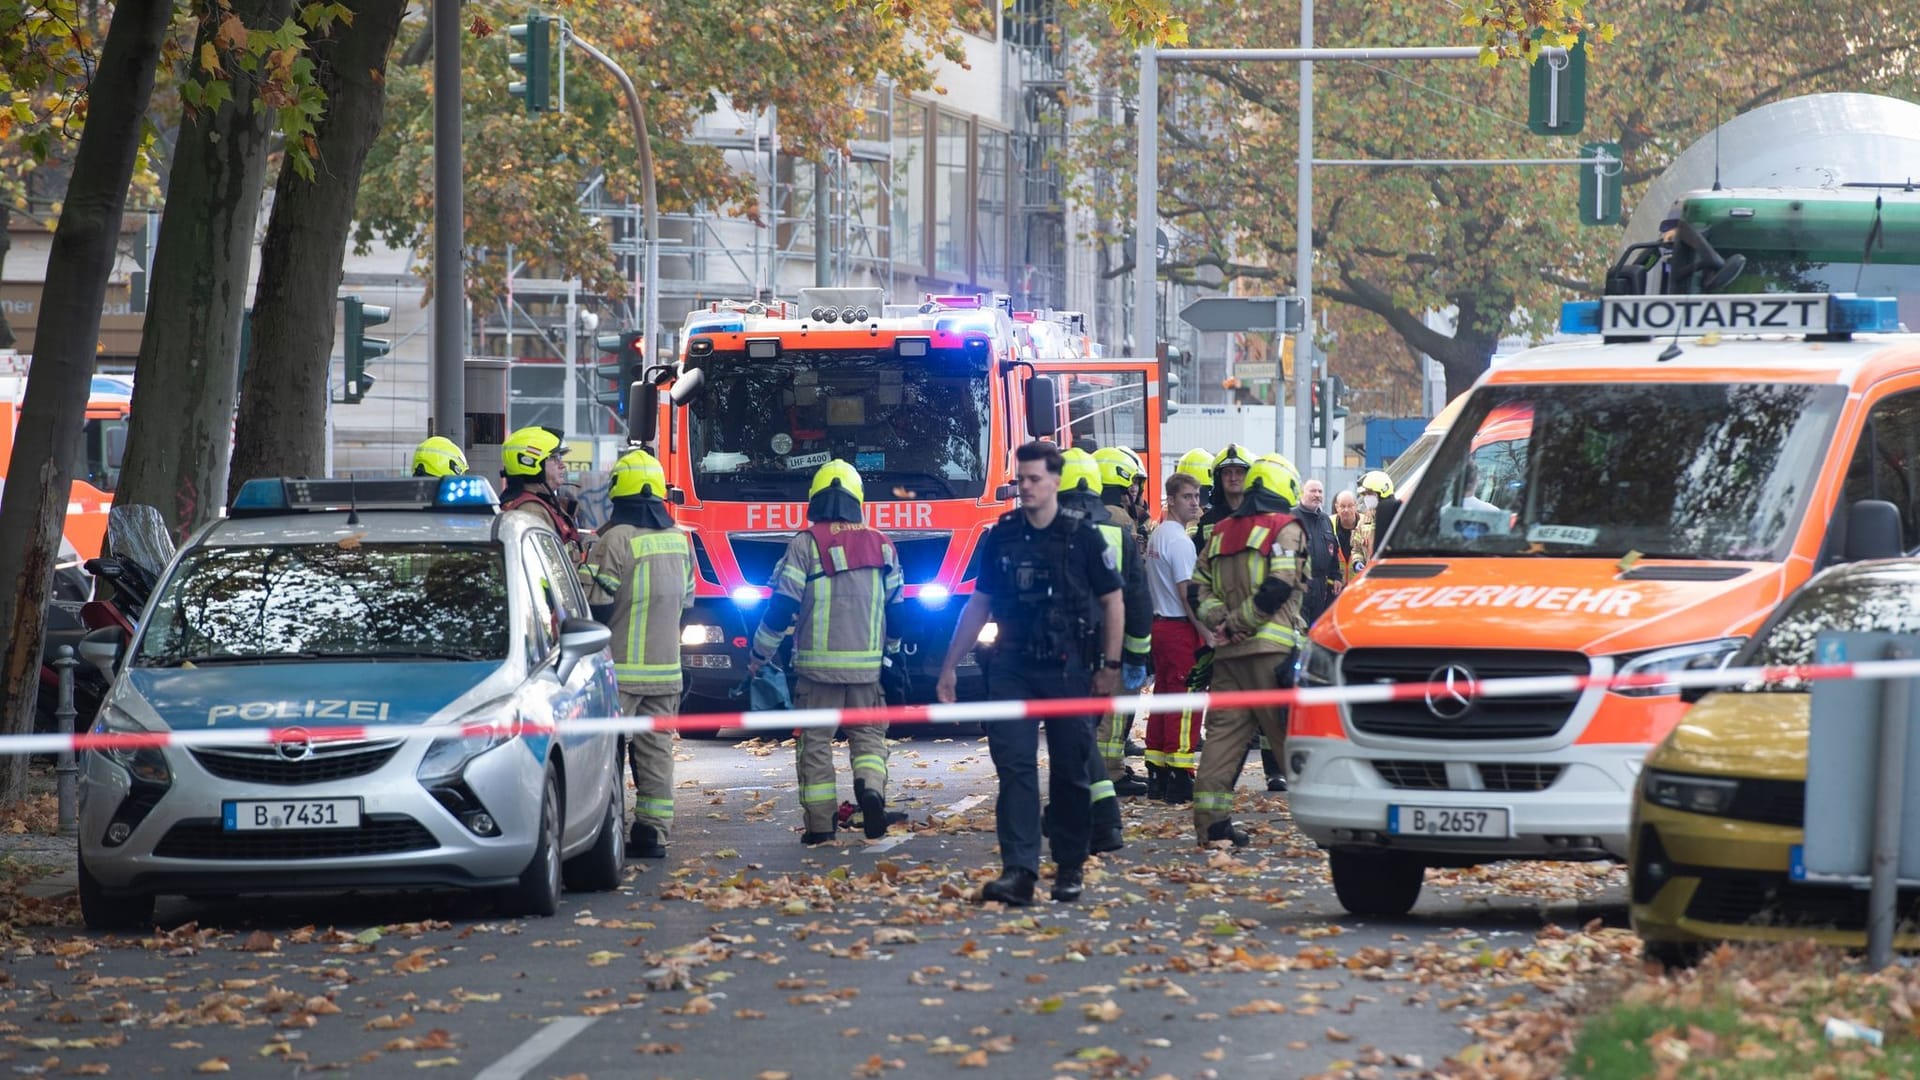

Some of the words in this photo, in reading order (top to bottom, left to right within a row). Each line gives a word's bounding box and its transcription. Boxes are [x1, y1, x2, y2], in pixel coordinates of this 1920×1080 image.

[1611, 301, 1820, 328] NOTARZT
[790, 458, 805, 467] LHF
[807, 454, 827, 464] 4400
[746, 503, 933, 528] FEUWEHR
[1352, 585, 1643, 617] FEUERWEHR
[207, 700, 390, 726] POLIZEI
[255, 805, 268, 826] B
[283, 804, 338, 825] 7431
[1413, 810, 1425, 831] B
[1439, 811, 1488, 833] 2657
